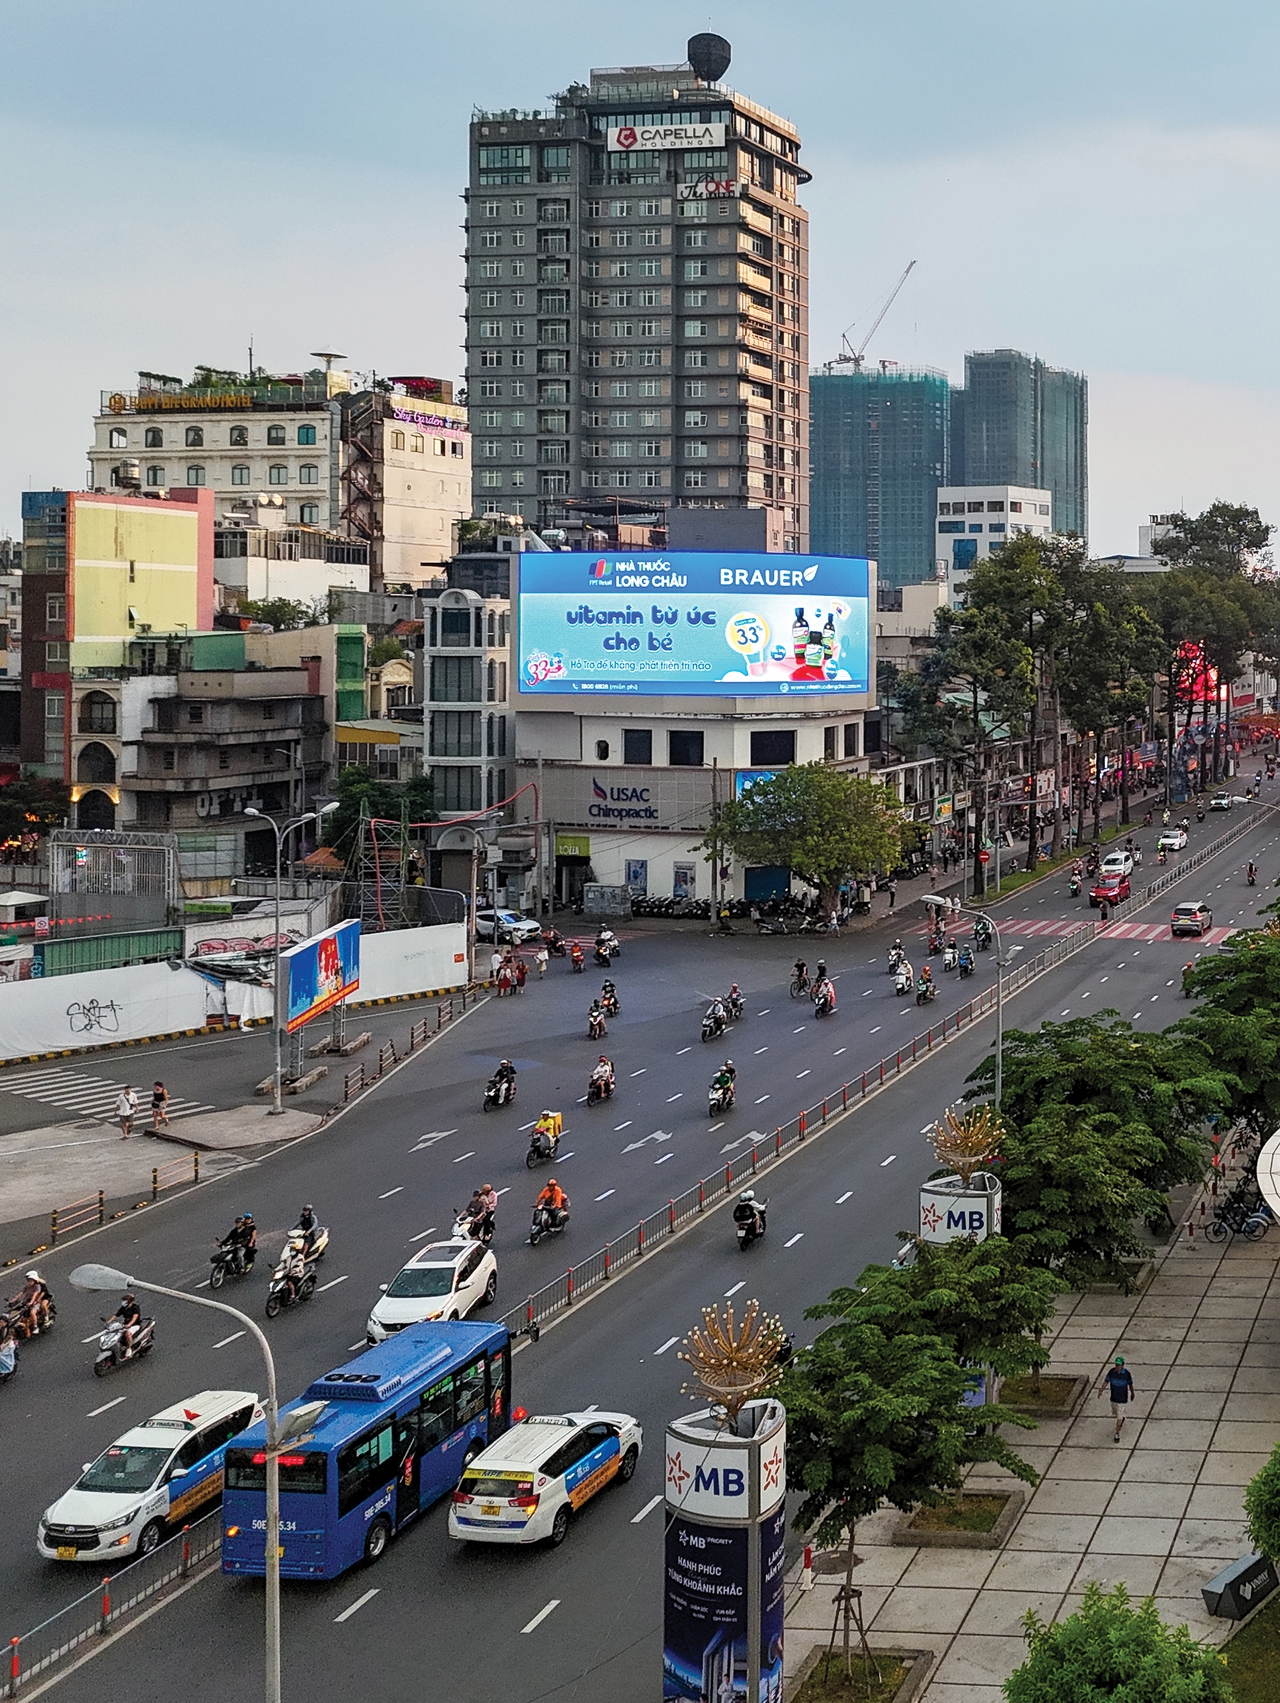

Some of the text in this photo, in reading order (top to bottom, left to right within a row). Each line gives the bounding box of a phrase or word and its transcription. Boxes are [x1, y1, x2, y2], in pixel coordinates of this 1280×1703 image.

[641, 127, 714, 141] CAPELLA
[641, 140, 714, 148] HOLDINGS
[705, 180, 735, 194] ONE
[181, 393, 220, 409] GRAND
[220, 393, 253, 408] HOTEL
[393, 406, 444, 427] Sky Garden
[615, 557, 671, 572] NHÀ THUỐC
[615, 572, 688, 588] LONG CHÂU
[719, 567, 804, 587] BRAUER
[566, 604, 644, 626] vitamin
[651, 604, 679, 626] từ
[686, 605, 717, 626] úc
[603, 631, 673, 651] cho bé
[610, 787, 650, 802] USAC
[588, 804, 659, 821] Chiropractic
[946, 1210, 985, 1231] MB
[694, 1465, 745, 1497] MB
[252, 1519, 296, 1532] 50E5.34
[689, 1535, 733, 1550] MB PRIORITY
[677, 1556, 722, 1576] HẠNH PHÚC
[716, 1582, 743, 1596] KHẮC
